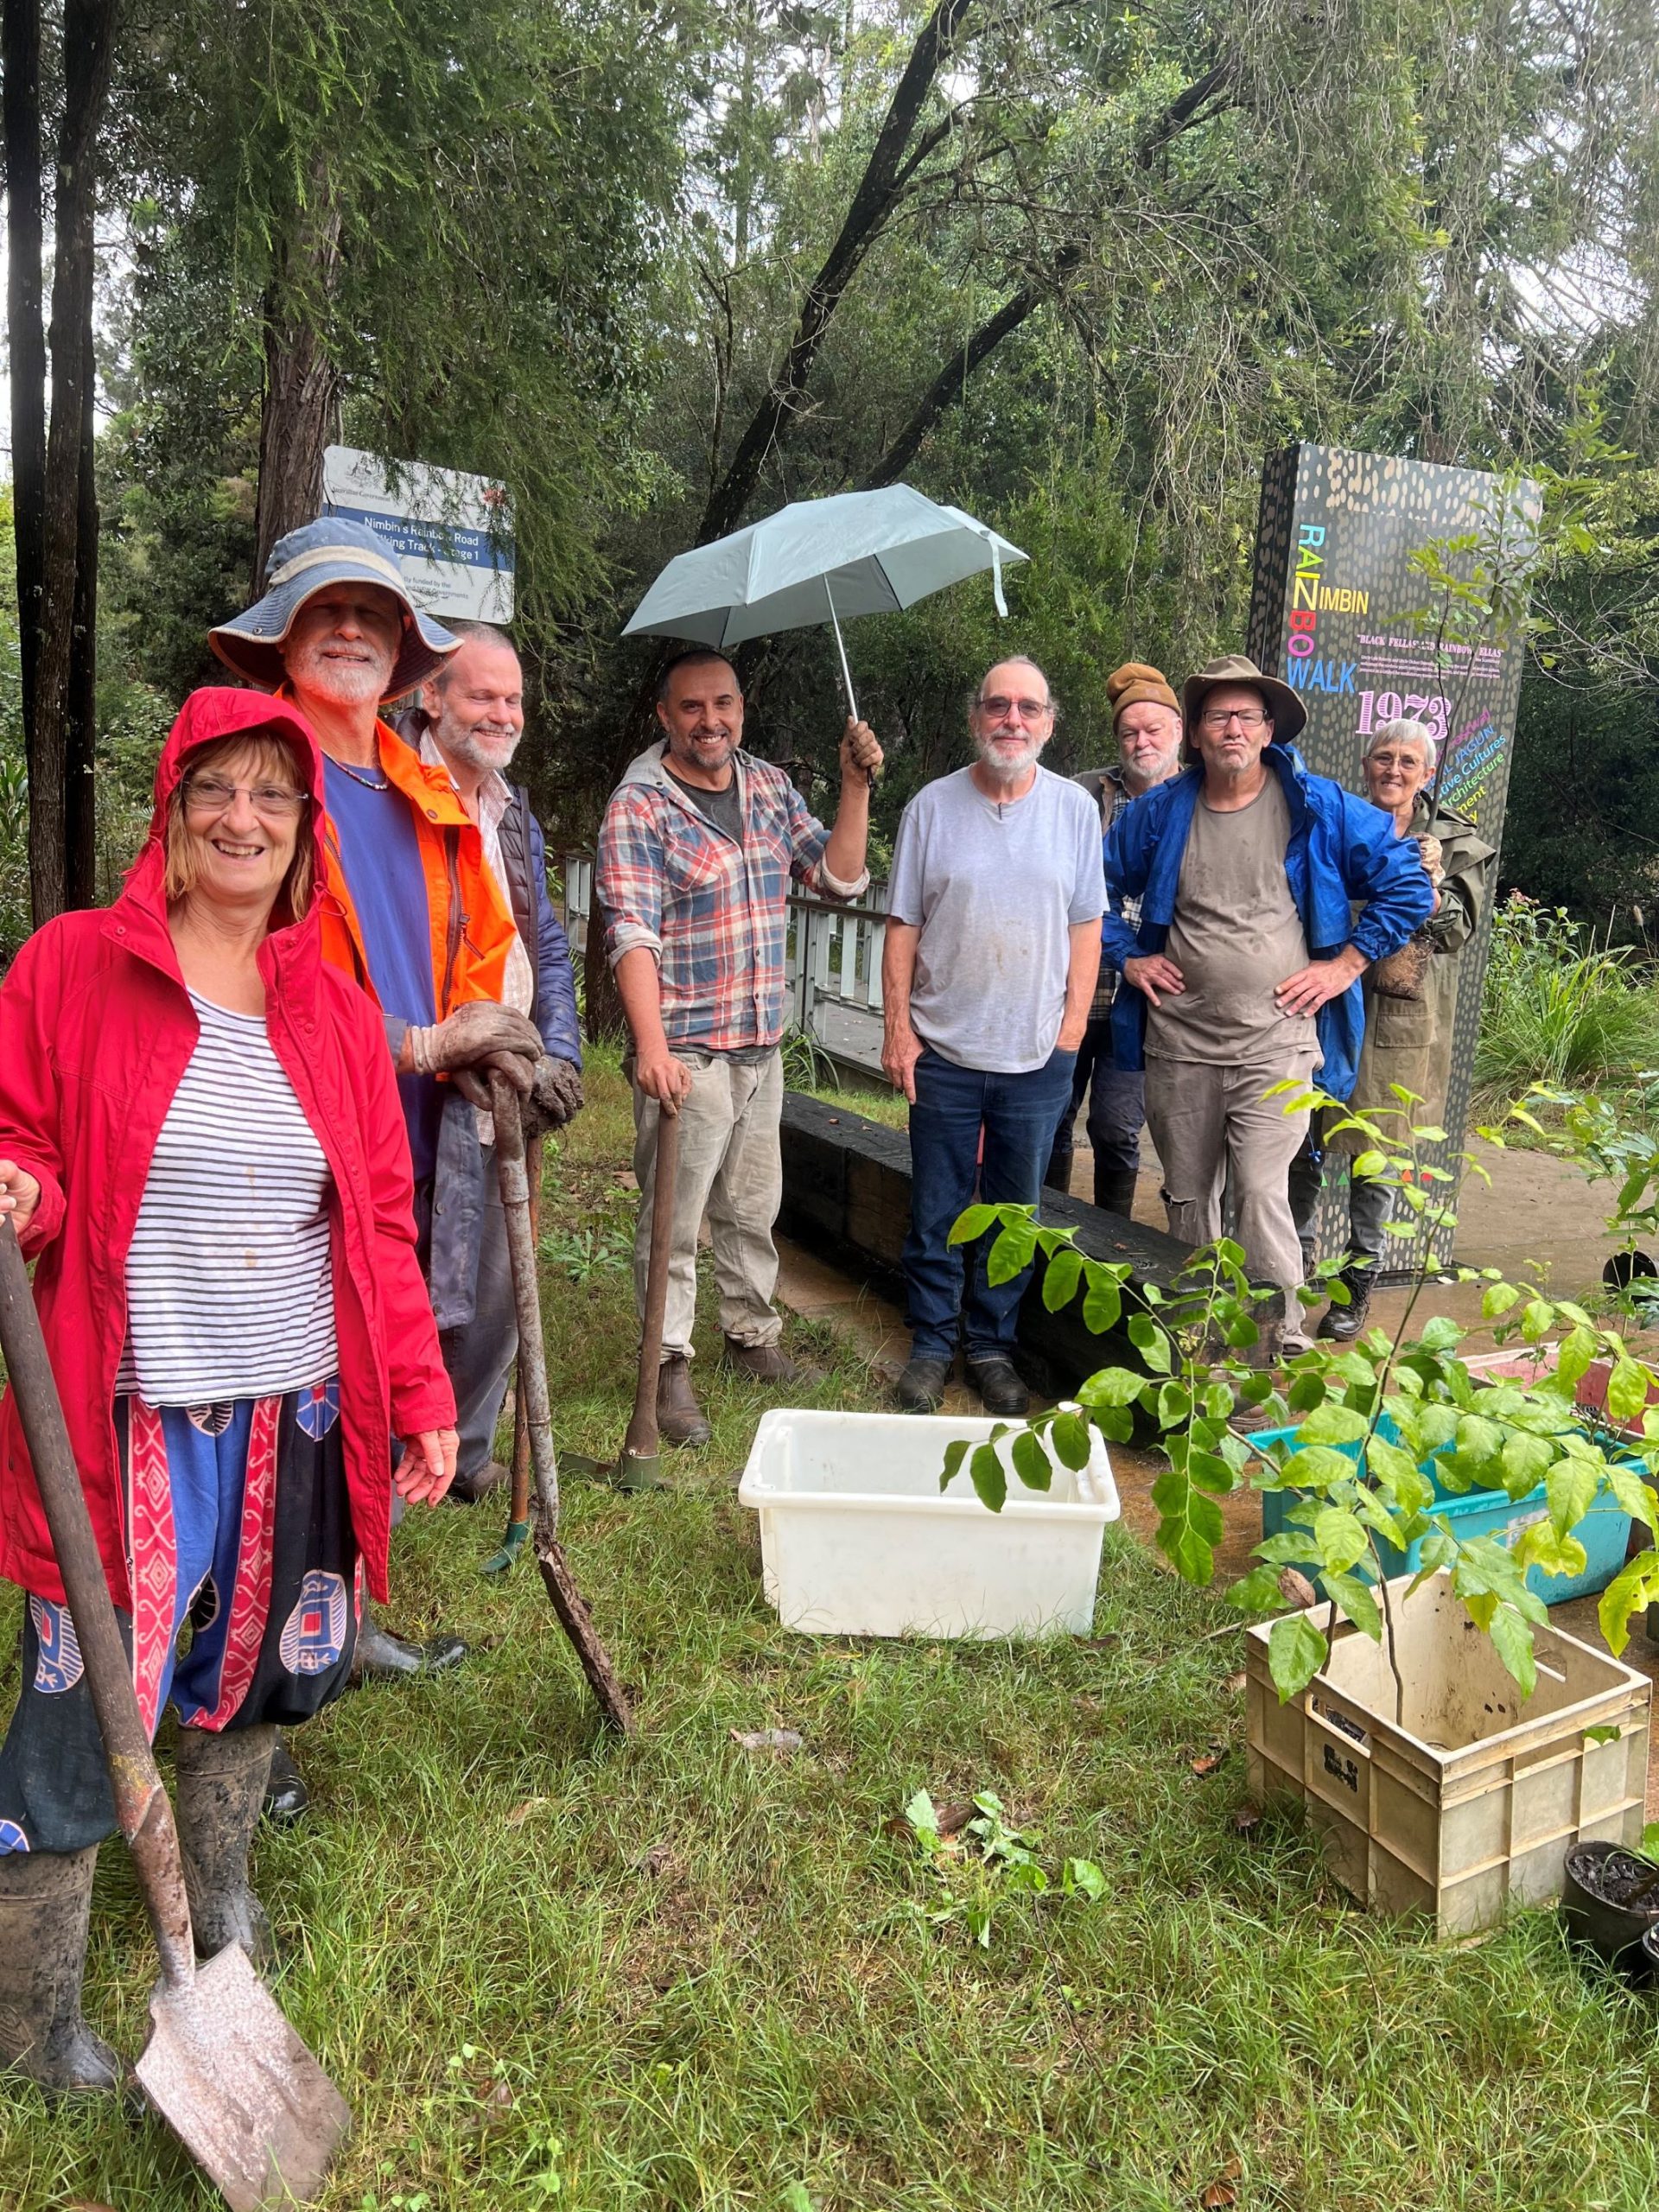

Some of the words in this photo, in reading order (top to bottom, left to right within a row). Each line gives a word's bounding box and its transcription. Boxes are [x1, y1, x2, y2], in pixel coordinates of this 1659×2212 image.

[365, 516, 409, 534] Nimbins
[410, 525, 452, 542] Rainbo
[454, 532, 479, 546] Road
[378, 534, 405, 550] lking
[407, 538, 435, 553] Track
[474, 550, 479, 561] 1
[1478, 646, 1505, 658] ELLAS"
[1287, 657, 1357, 694] WALK
[1355, 690, 1452, 741] 1973
[1461, 734, 1507, 776] Cultures
